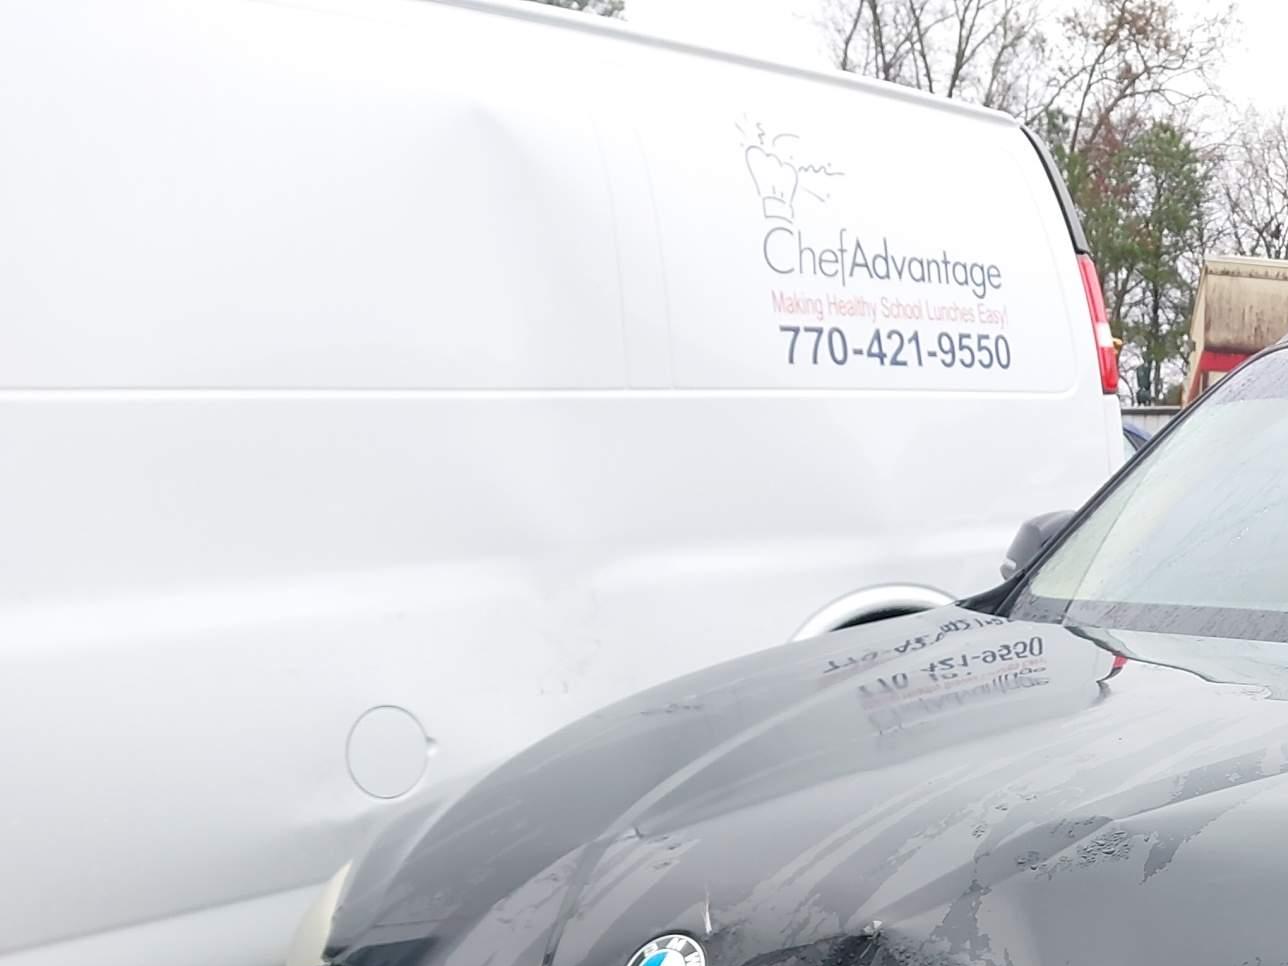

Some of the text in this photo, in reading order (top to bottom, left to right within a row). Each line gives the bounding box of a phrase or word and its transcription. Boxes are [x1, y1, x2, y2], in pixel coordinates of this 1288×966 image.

[763, 227, 1002, 300] ChefAdvantage
[771, 289, 1008, 329] Making Healthy School Lunches Easy!
[779, 324, 1012, 370] 770-421-9550
